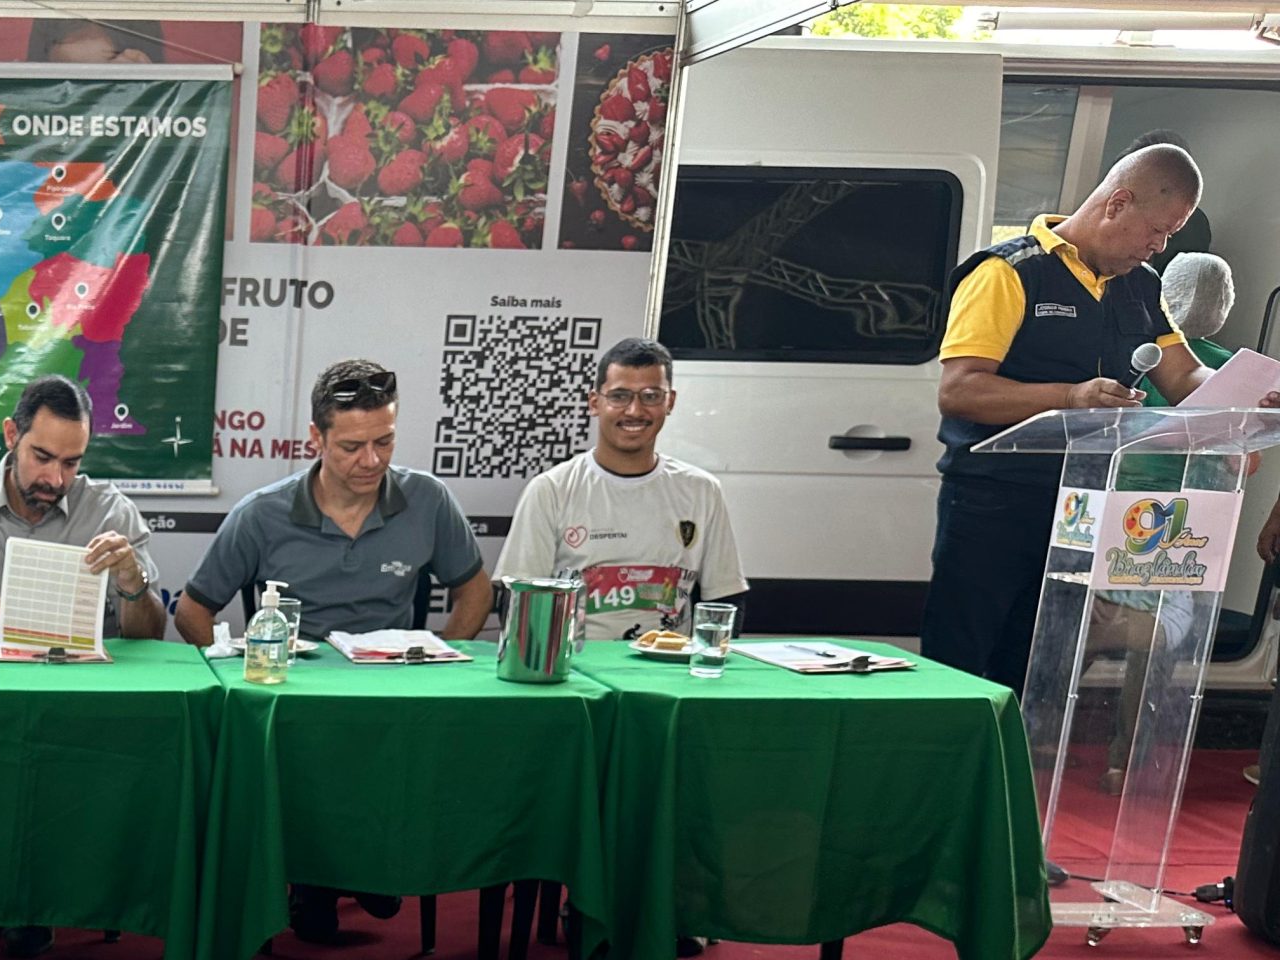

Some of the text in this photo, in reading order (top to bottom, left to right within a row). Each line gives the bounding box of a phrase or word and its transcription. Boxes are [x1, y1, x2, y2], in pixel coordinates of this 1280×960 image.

[12, 115, 207, 138] ONDE ESTAMOS
[220, 277, 334, 310] FRUTO
[490, 295, 562, 308] Saiba mais
[230, 438, 265, 459] NA
[271, 439, 323, 460] MES
[143, 514, 177, 531] ção
[1123, 498, 1189, 556] 91
[589, 585, 636, 610] 149
